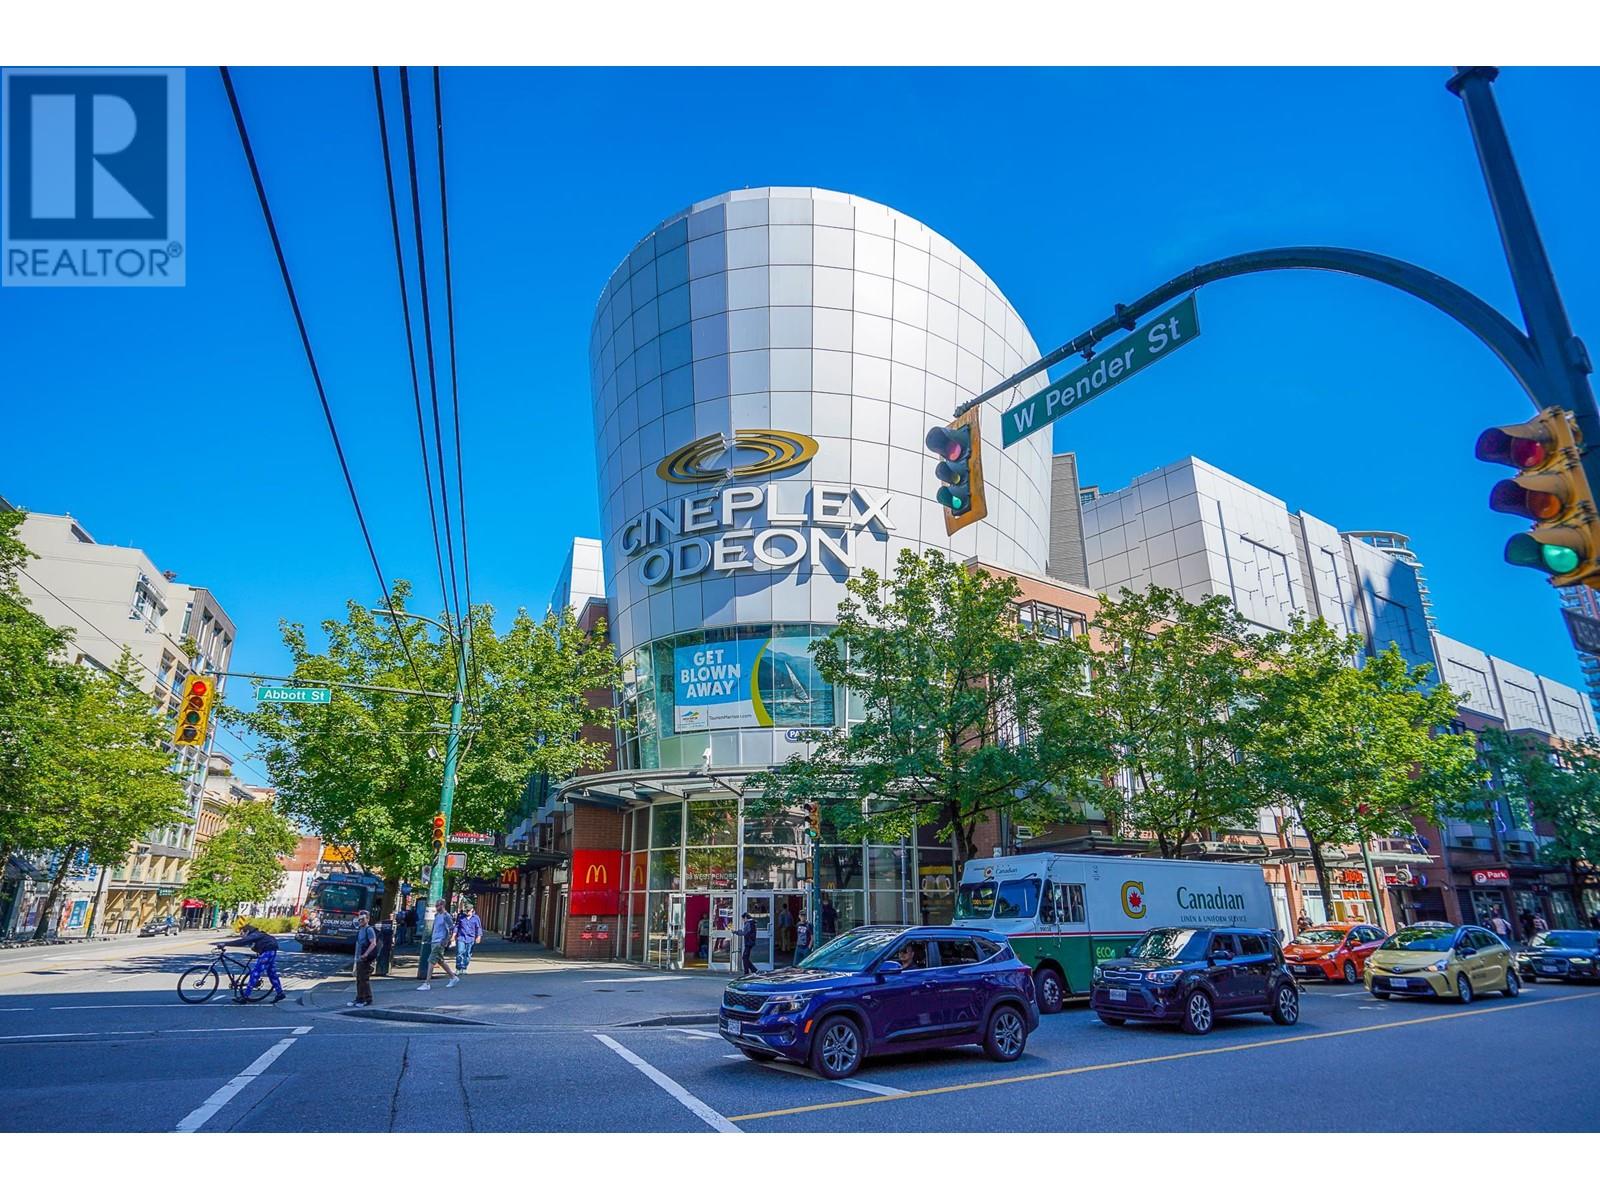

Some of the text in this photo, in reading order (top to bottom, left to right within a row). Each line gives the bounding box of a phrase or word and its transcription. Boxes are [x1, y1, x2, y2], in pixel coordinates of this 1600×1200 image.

[1013, 316, 1181, 433] W Pender St
[619, 484, 897, 557] CINEPLEX
[638, 527, 857, 587] ODEON
[693, 649, 725, 666] GET
[680, 664, 741, 684] BLOWN
[264, 689, 325, 701] Abbott St
[686, 680, 736, 699] AWAY
[1487, 871, 1507, 879] Park
[1176, 886, 1245, 910] Canadian
